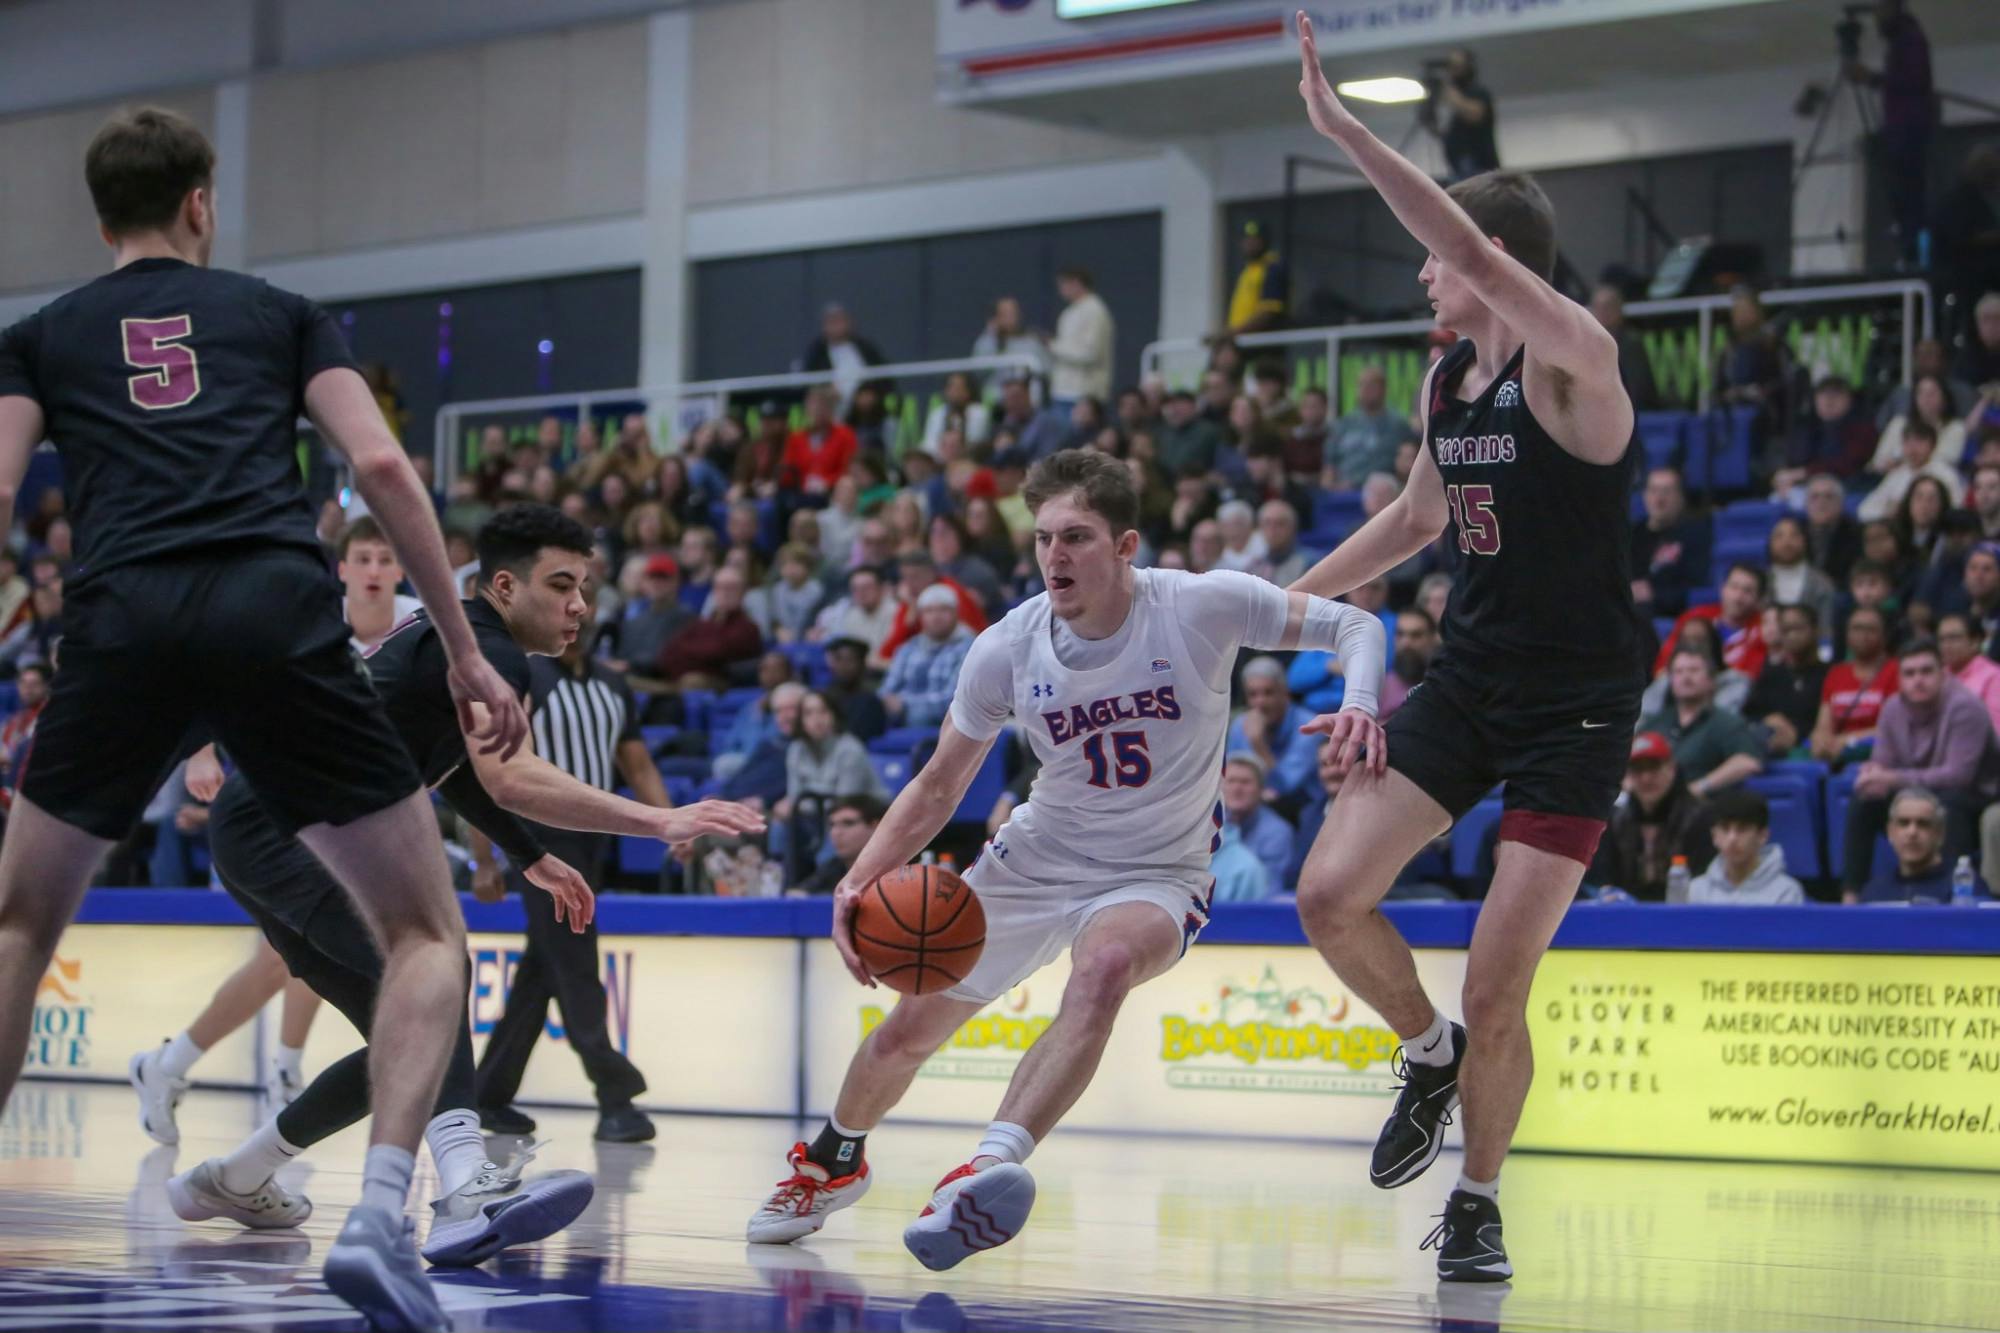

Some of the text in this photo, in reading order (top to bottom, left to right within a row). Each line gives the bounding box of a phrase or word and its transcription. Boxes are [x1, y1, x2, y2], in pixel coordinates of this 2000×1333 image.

[121, 314, 201, 410] 5
[1435, 434, 1516, 465] EOPARDS
[1447, 484, 1501, 555] 15
[1041, 685, 1182, 746] EAGLES
[1083, 730, 1152, 789] 15
[1701, 980, 2000, 1007] THE PREFERRED HOTEL PART
[1546, 1001, 1675, 1023] GLOVER
[1702, 1012, 1819, 1035] AMERICAN
[1828, 1014, 1956, 1039] UNIVERSITY
[1569, 1036, 1651, 1056] PARK
[1721, 1043, 1761, 1066] USE
[1768, 1044, 1878, 1069] BOOKING
[1886, 1047, 1950, 1071] CODE
[1559, 1070, 1660, 1093] HOTEL
[1708, 1097, 2000, 1134] www.GloverParkHotel.
